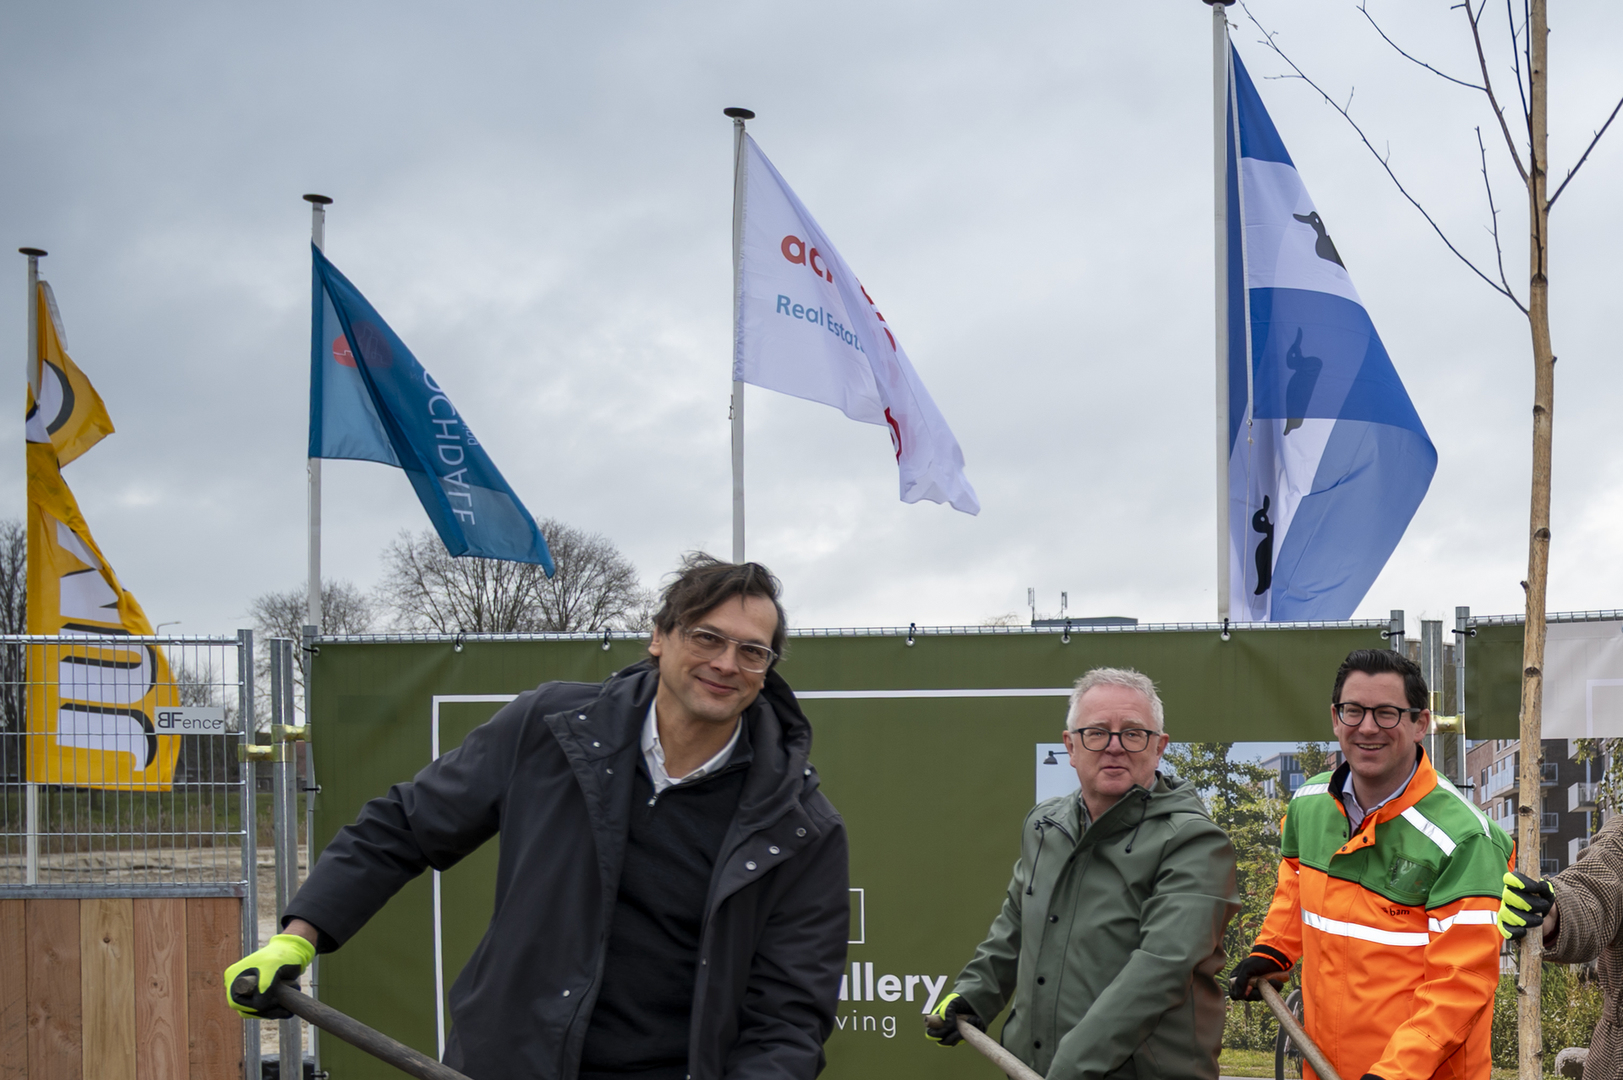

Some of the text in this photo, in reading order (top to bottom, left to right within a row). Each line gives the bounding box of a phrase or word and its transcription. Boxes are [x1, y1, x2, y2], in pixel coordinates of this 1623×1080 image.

[776, 293, 824, 327] Real
[157, 711, 223, 730] BFence
[1389, 907, 1410, 917] bam
[835, 1009, 897, 1039] ving
